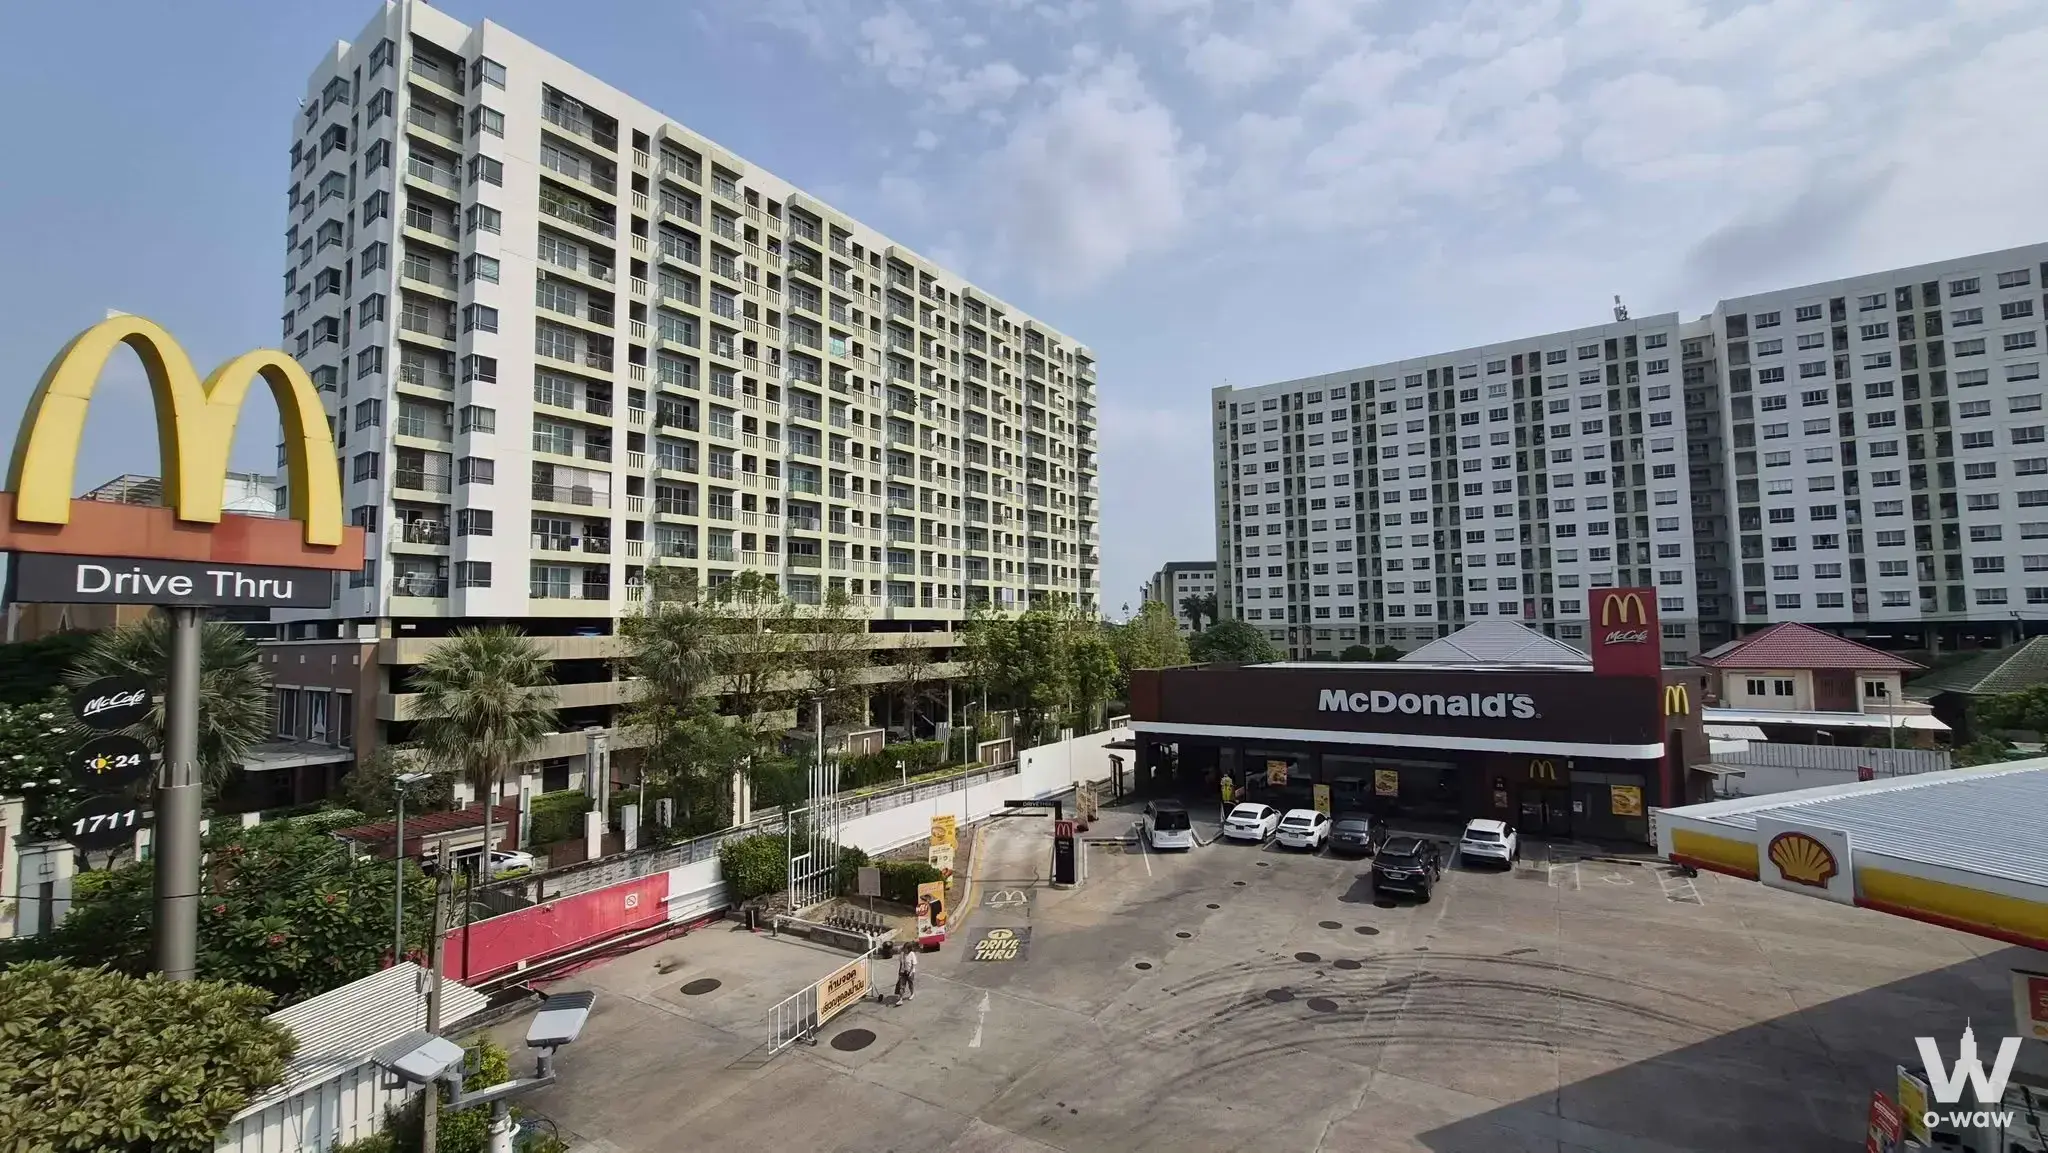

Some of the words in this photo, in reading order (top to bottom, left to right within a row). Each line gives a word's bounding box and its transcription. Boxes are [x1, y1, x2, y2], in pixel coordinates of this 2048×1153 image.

[76, 564, 194, 596] Drive
[206, 570, 293, 599] Thru
[1318, 689, 1536, 719] McDonald's
[115, 753, 141, 768] 24
[72, 809, 136, 835] 1711
[975, 939, 1019, 950] DRIVE
[975, 949, 1018, 960] THRU
